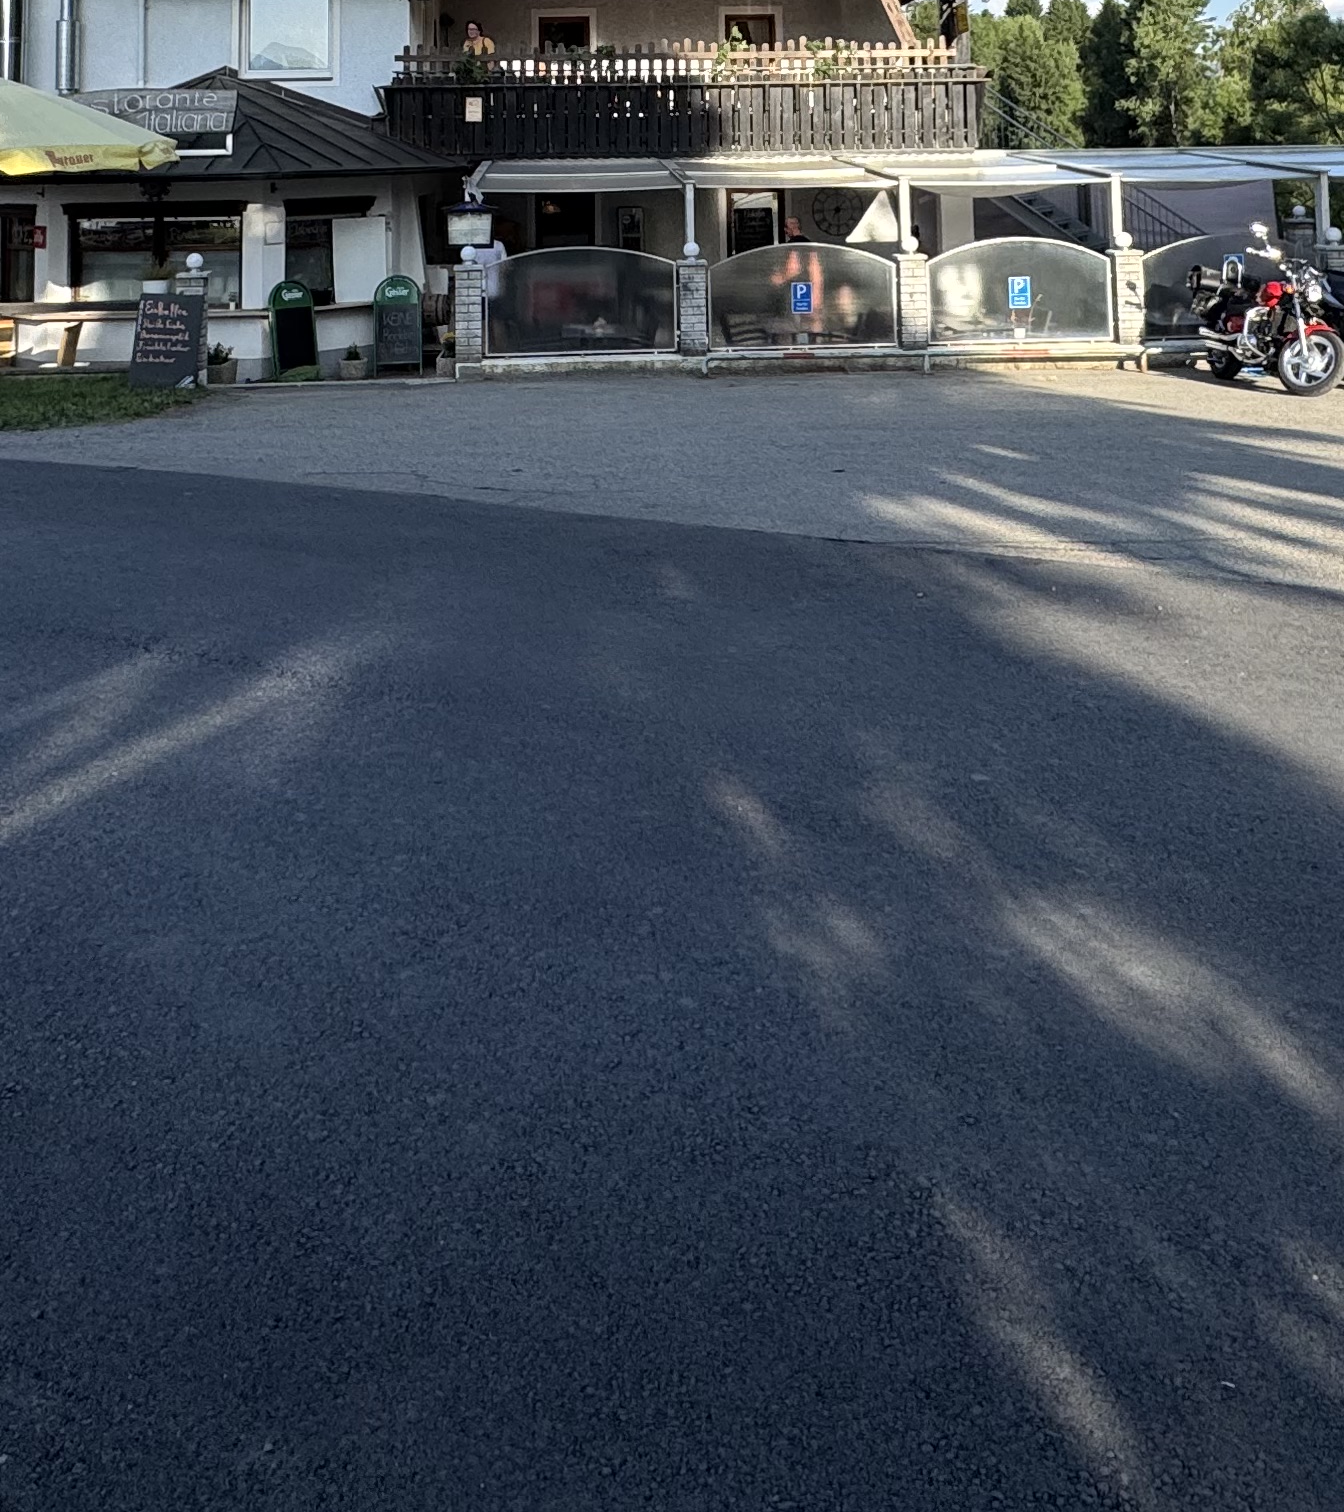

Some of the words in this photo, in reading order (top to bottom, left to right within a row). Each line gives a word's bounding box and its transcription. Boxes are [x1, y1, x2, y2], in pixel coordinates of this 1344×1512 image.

[90, 92, 218, 115] storante
[796, 284, 807, 299] P
[1013, 278, 1024, 294] P
